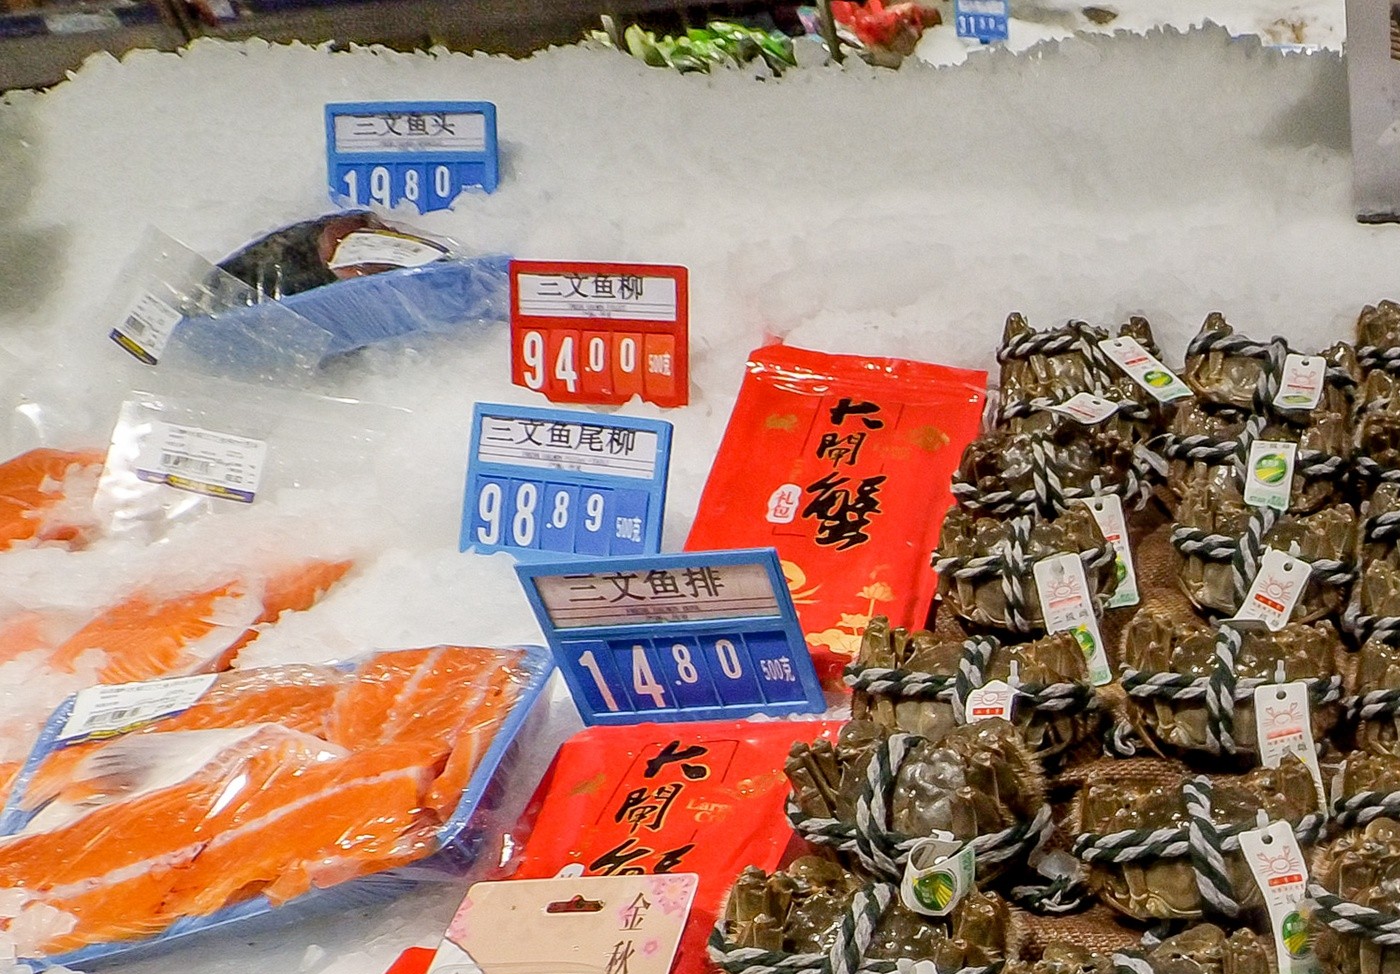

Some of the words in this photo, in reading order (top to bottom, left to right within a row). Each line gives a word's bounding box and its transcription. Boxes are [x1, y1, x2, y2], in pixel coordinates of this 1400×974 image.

[353, 113, 455, 136] 三文鱼头
[537, 274, 644, 300] 三文鱼柳
[523, 331, 636, 393] 94.00
[486, 416, 636, 455] 三文鱼尾柳
[476, 482, 605, 547] 98.89
[563, 566, 725, 603] 三文鱼排
[578, 639, 743, 712] 14.80
[760, 655, 796, 683] 500克
